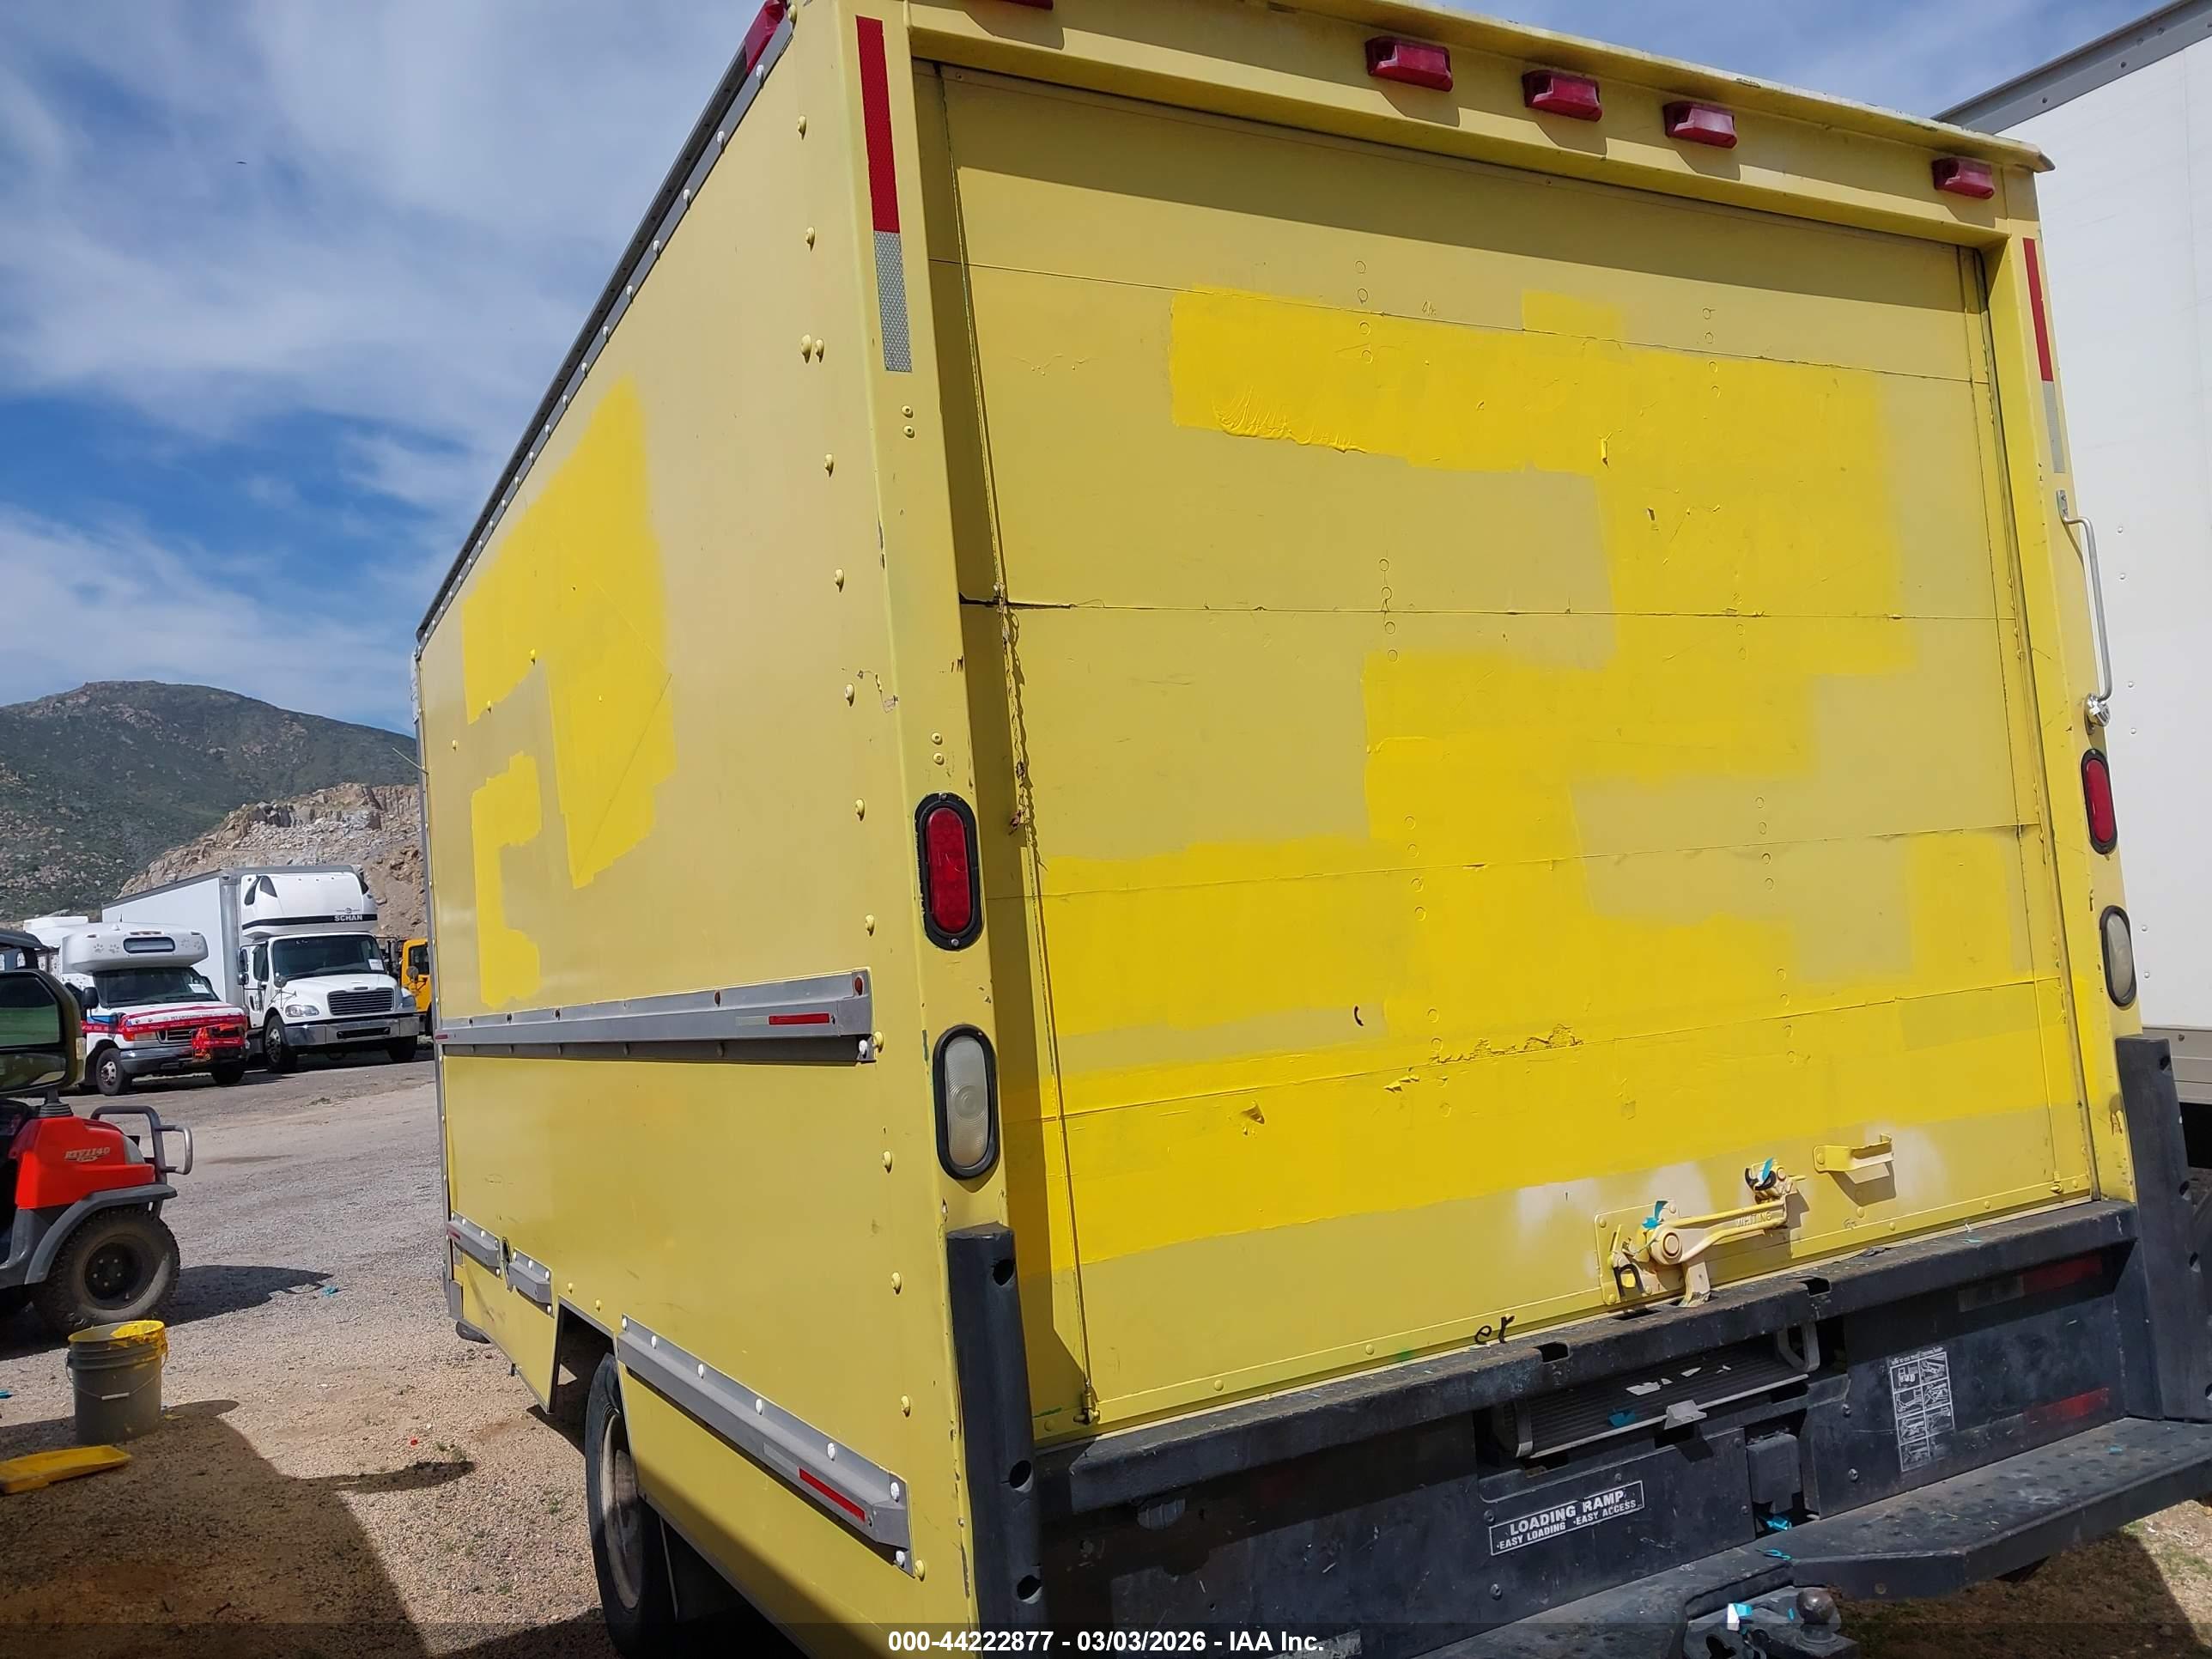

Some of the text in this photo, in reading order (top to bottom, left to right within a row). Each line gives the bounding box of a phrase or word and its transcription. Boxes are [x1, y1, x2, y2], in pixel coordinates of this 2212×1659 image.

[1510, 1490, 1625, 1536] LOADING RAMP
[1527, 1522, 1566, 1541] LOADING
[1602, 1499, 1637, 1521] ACCESS
